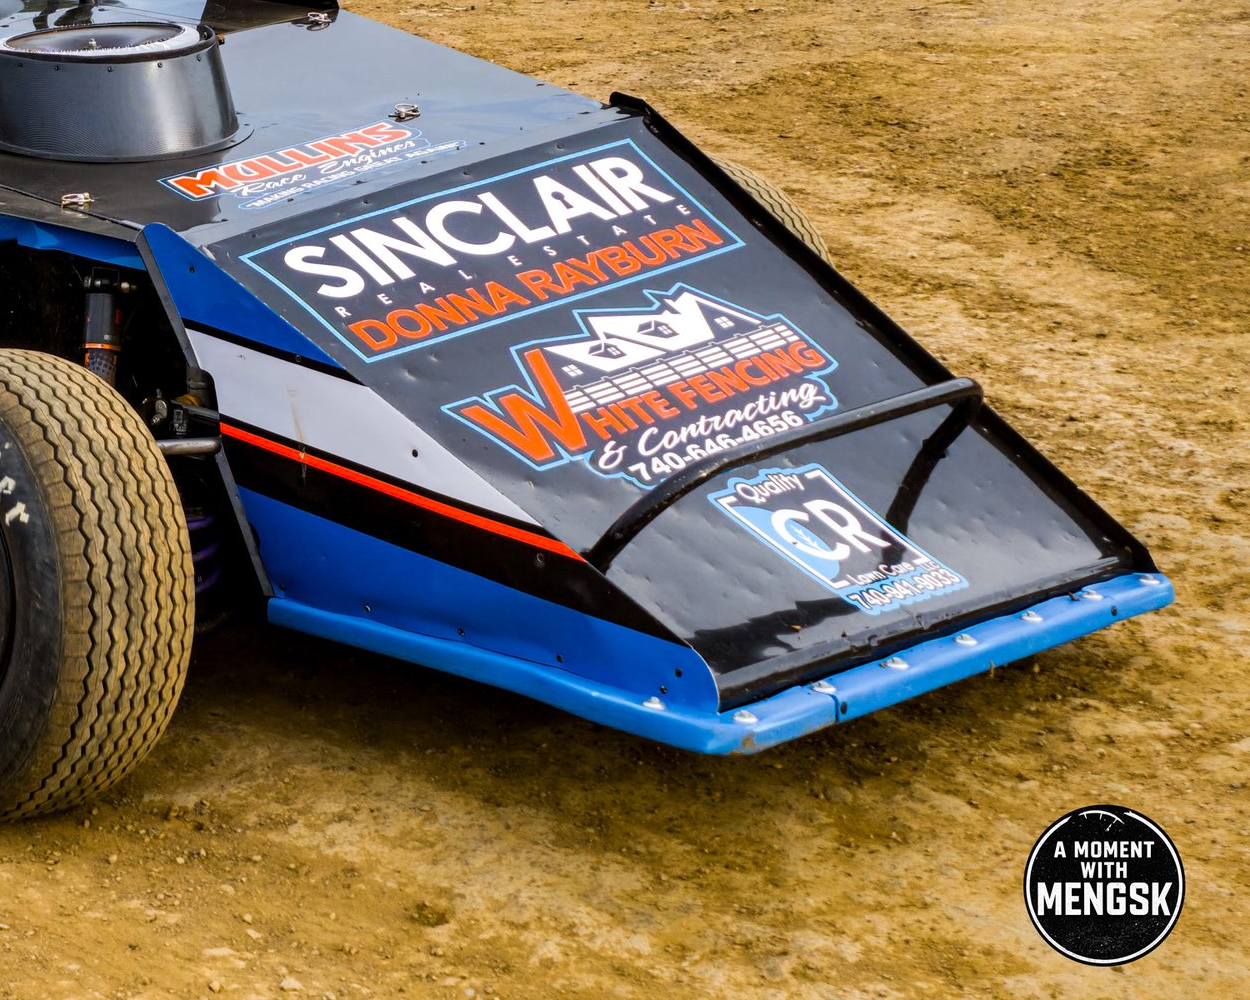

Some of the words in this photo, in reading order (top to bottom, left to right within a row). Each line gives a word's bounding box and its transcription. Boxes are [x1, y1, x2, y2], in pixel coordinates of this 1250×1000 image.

[167, 122, 412, 199] MULLINS
[232, 173, 307, 197] Race
[317, 140, 416, 174] Engines
[283, 155, 676, 299] SINCLAIR
[335, 268, 474, 318] REAL
[510, 203, 691, 267] ESTATE
[348, 281, 531, 351] DONNA
[516, 218, 724, 296] RAYBURN
[460, 349, 678, 461] WHITE
[664, 341, 827, 414] FENCING
[598, 441, 627, 470] &
[637, 377, 826, 457] Contracting
[628, 410, 804, 481] 740-646-4656
[735, 473, 805, 504] Quality
[770, 499, 892, 561] CR
[845, 569, 887, 586] Lawn
[877, 560, 915, 577] Care
[847, 568, 961, 610] 740-941-9033
